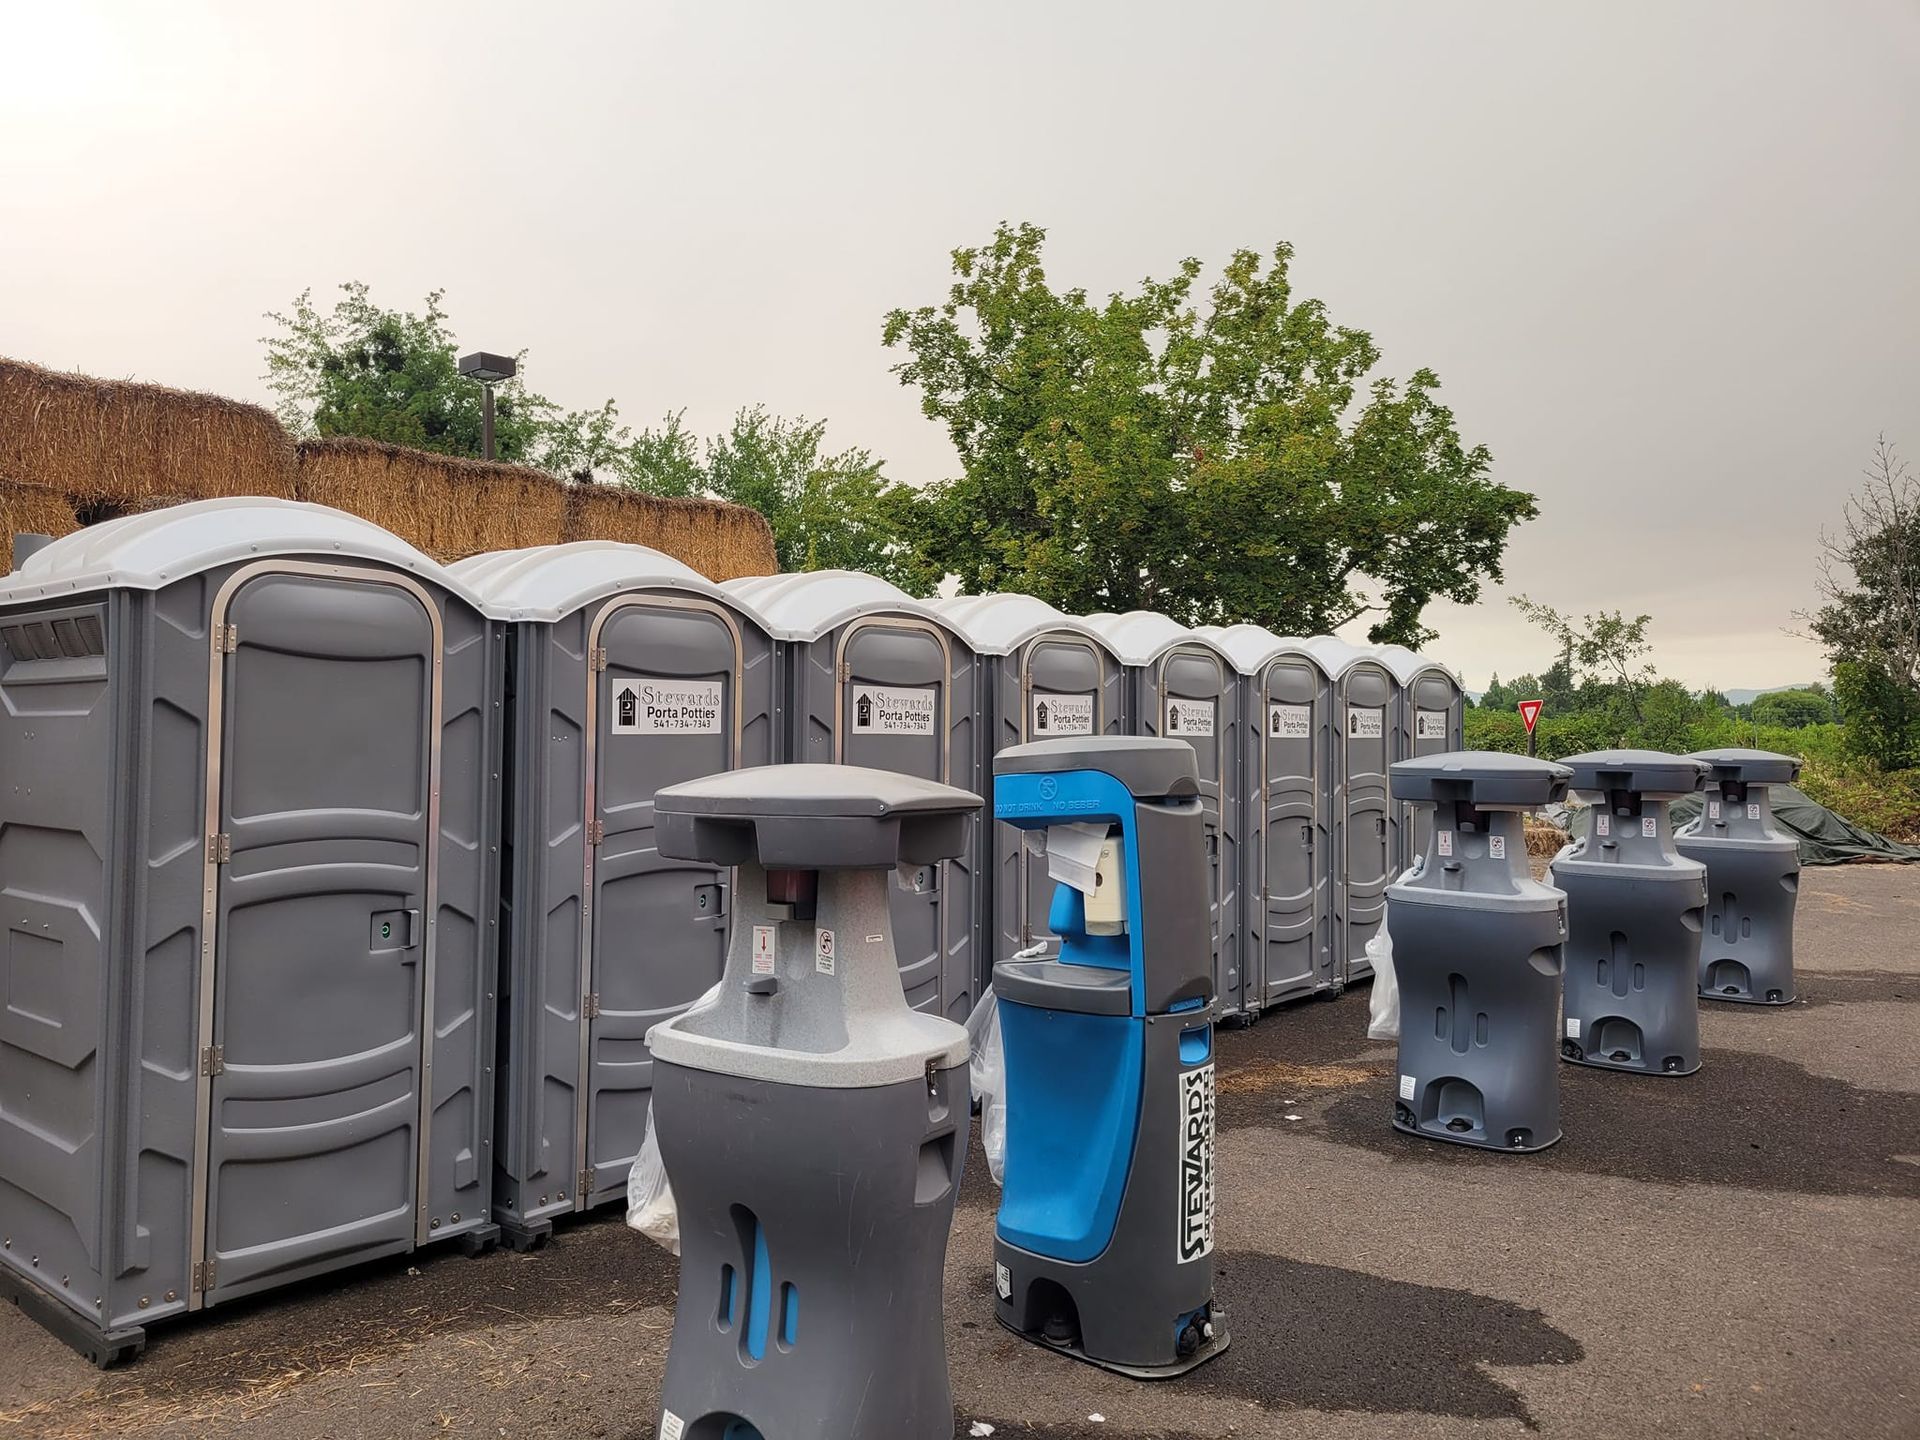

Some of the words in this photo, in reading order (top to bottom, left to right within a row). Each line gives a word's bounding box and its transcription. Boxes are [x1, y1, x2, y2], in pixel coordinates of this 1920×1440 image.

[641, 685, 720, 706] Stewards
[875, 692, 933, 711] Stewards
[647, 706, 678, 719] Porta
[681, 706, 716, 719] Potties
[1050, 699, 1092, 714] Stewards
[879, 709, 903, 721] Porta
[904, 710, 930, 722] Potties
[1053, 714, 1071, 724] Porta
[1072, 714, 1090, 724] Potties
[653, 719, 711, 729] 541-734-7343
[884, 721, 927, 730] 541-734-7343
[1003, 803, 1017, 813] NOT
[1019, 802, 1042, 812] DRINK
[1053, 800, 1066, 810] NO
[1067, 799, 1101, 810] BEBER
